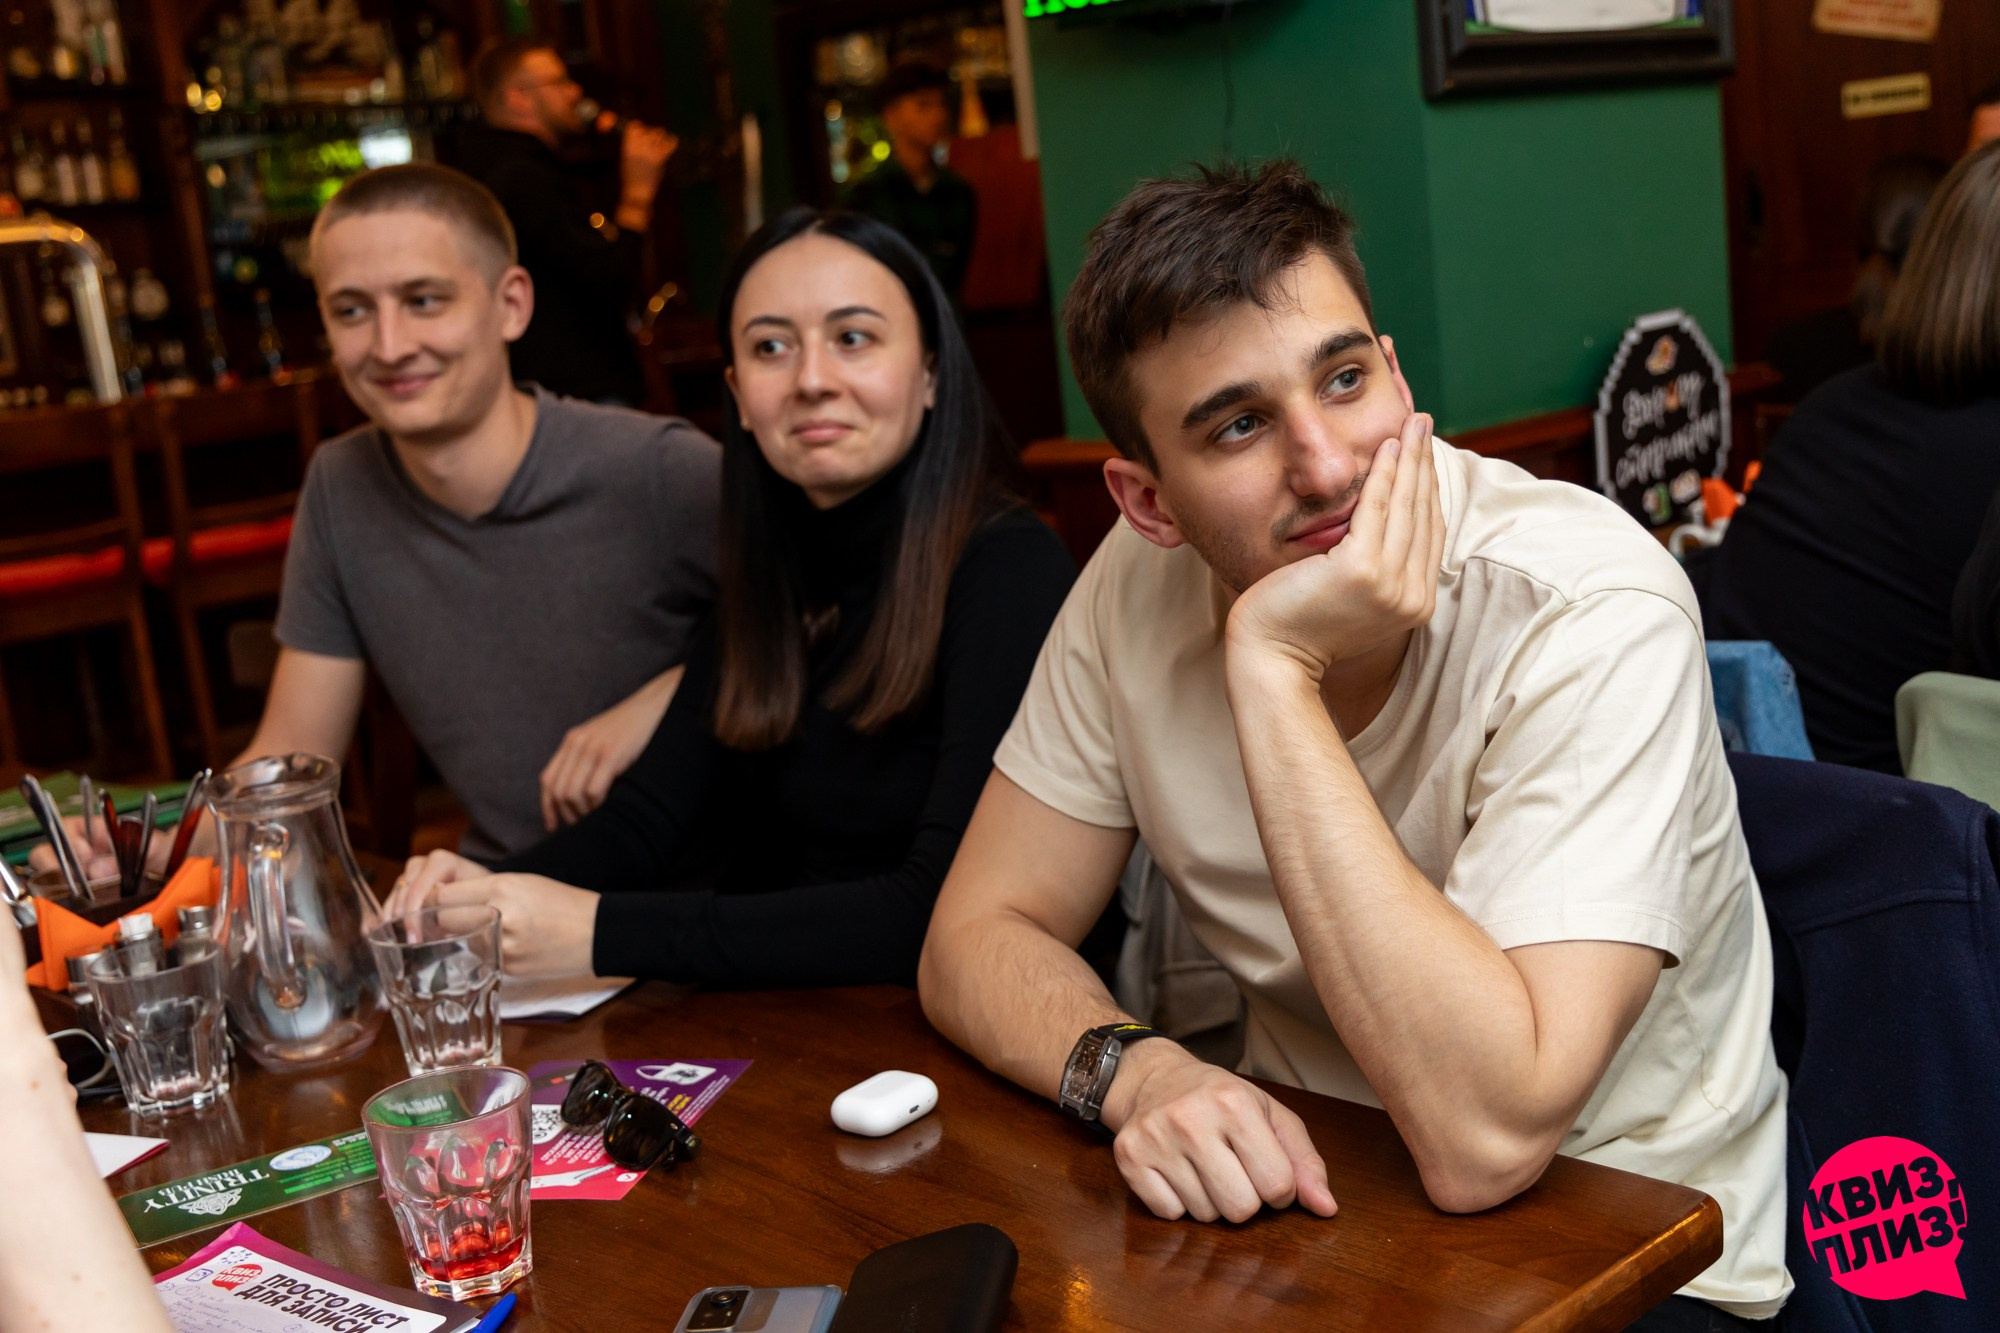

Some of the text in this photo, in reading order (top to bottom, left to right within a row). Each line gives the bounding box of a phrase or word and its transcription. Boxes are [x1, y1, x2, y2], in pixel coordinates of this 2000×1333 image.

[143, 1168, 270, 1213] TRINITY
[158, 1168, 240, 1197] IRISH PUB
[234, 1285, 291, 1308] ДЛЯ
[281, 1299, 373, 1333] ЗАПИСИ
[261, 1273, 350, 1309] ПРОСТО
[341, 1302, 410, 1329] ЛИСТ
